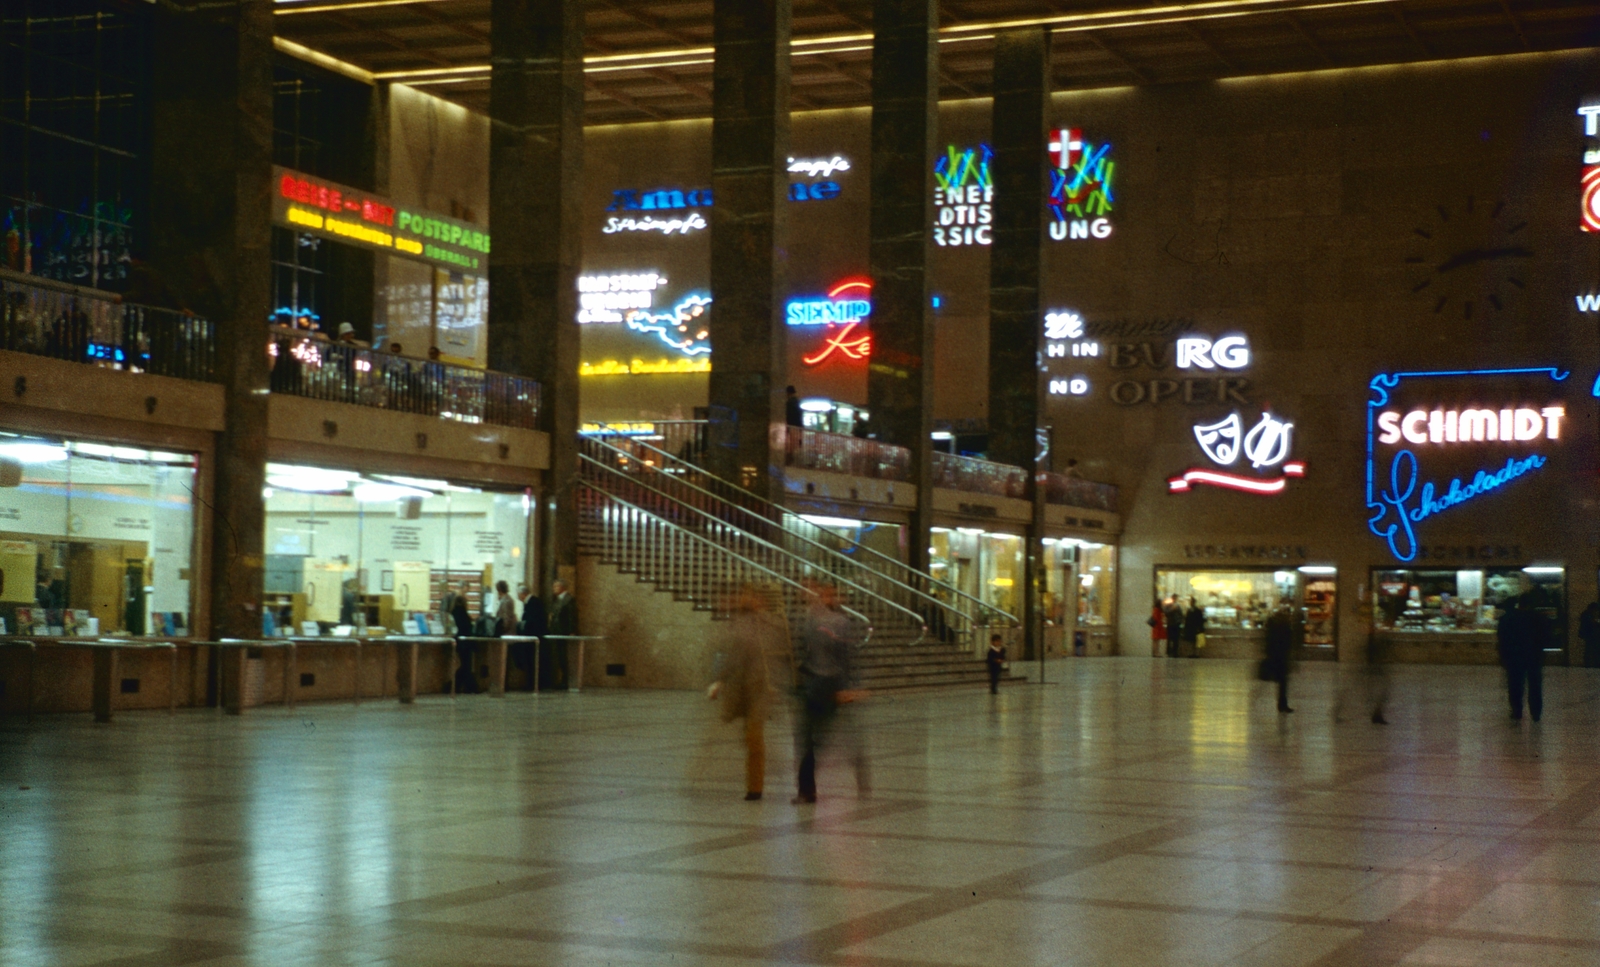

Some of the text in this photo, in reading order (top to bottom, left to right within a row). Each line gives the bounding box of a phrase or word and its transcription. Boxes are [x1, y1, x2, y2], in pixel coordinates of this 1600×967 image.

[934, 204, 992, 226] DTIS
[1377, 406, 1566, 444] SCHMIDT
[1381, 449, 1547, 561] Schokoladen
